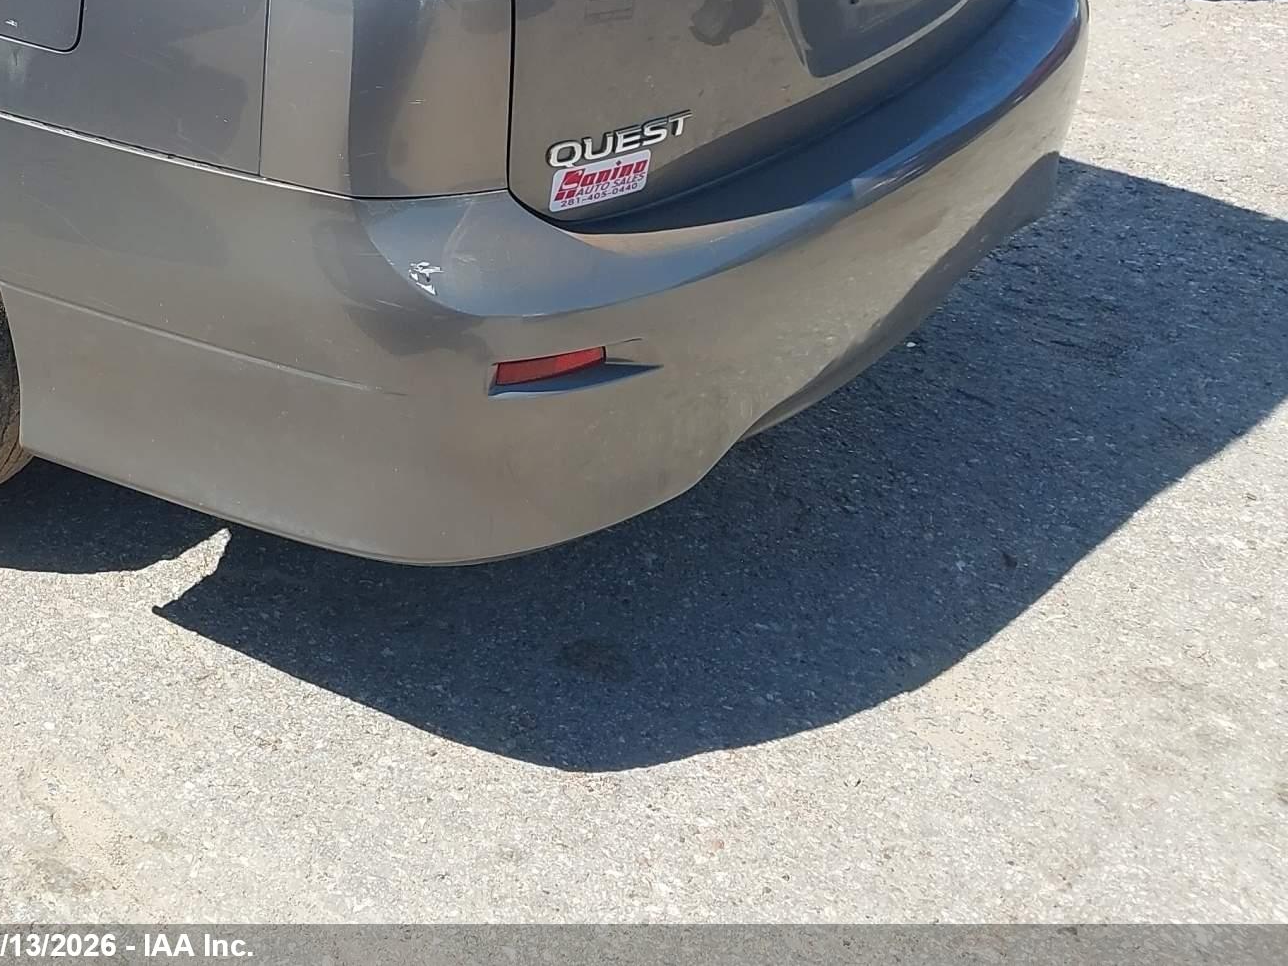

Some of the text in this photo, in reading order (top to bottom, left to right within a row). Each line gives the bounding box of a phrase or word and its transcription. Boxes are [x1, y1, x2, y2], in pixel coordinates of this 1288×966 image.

[549, 111, 693, 168] QUEST
[560, 183, 638, 208] 281-405-0440
[576, 172, 646, 196] AUTO SALES
